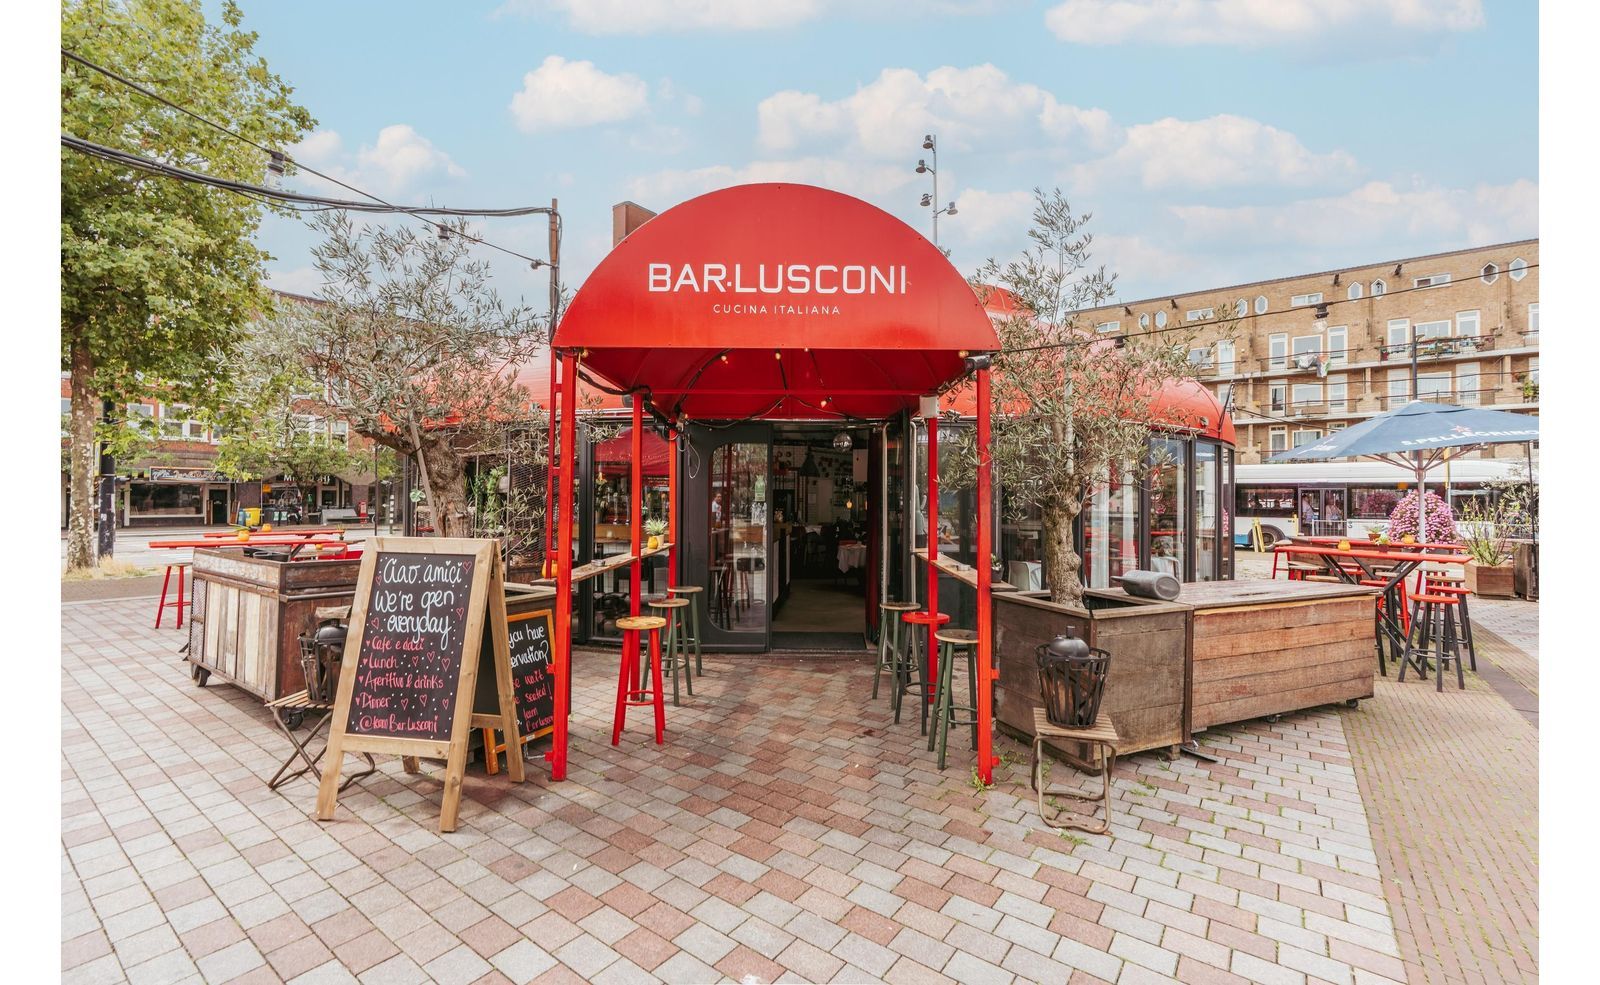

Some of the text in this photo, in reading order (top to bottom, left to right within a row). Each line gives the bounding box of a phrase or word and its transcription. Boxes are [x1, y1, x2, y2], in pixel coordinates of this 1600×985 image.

[713, 304, 840, 315] CUCINA ITALIANA
[375, 590, 454, 620] We're open
[387, 614, 452, 650] everyday
[525, 624, 545, 640] have
[369, 653, 399, 669] Lunch
[360, 692, 391, 709] Dinner
